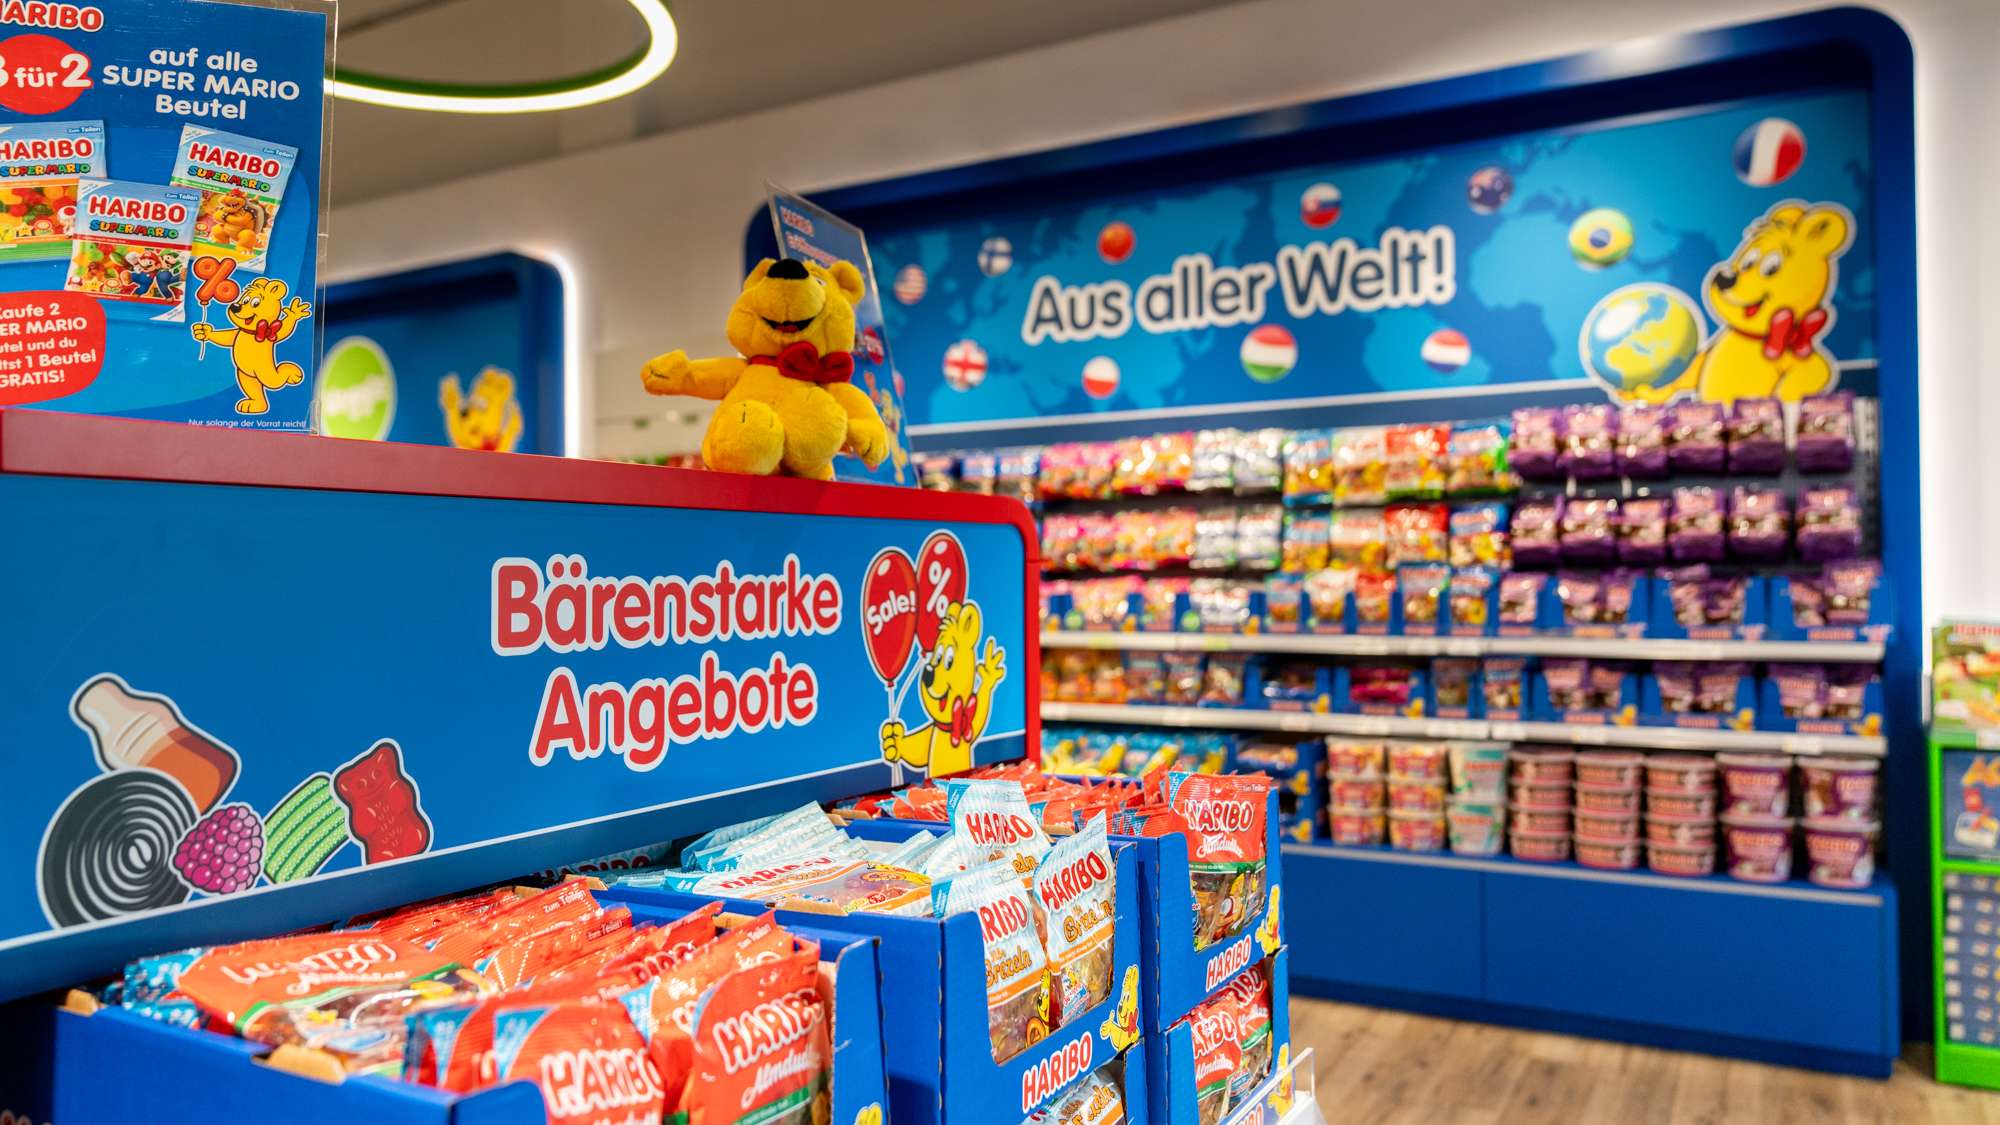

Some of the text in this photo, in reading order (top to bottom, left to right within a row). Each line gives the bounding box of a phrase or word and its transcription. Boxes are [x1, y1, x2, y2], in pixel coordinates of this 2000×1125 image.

[0, 0, 104, 32] ARIBO
[14, 67, 58, 88] für
[60, 53, 92, 88] 2
[149, 48, 258, 73] auf alle
[102, 65, 300, 100] SUPER MARIO
[155, 94, 246, 120] Beutel
[45, 163, 91, 175] MARIO
[189, 142, 280, 178] HARIBO
[187, 165, 271, 192] SUPER MARIO
[88, 194, 187, 224] HARIBO
[90, 220, 179, 239] SUPER MARIO
[1026, 231, 1450, 340] Aus aller Welt!
[0, 303, 60, 319] aufe 2
[0, 316, 87, 336] ER MARIO
[25, 355, 33, 368] 1
[39, 348, 96, 367] Beutel
[27, 338, 55, 351] und
[59, 337, 77, 348] du
[188, 418, 203, 426] Nur
[206, 418, 239, 428] solange
[240, 419, 254, 427] der
[256, 420, 281, 428] Vorrat
[495, 557, 840, 652] Bärenstarke
[867, 590, 916, 635] Sale!
[533, 653, 815, 768] Angebote
[1184, 799, 1254, 832] HARIBO
[1040, 850, 1108, 910] HARIBO
[978, 895, 1028, 943] RIBO
[1206, 934, 1252, 992] HARIBO
[1022, 1031, 1093, 1114] HARIBO
